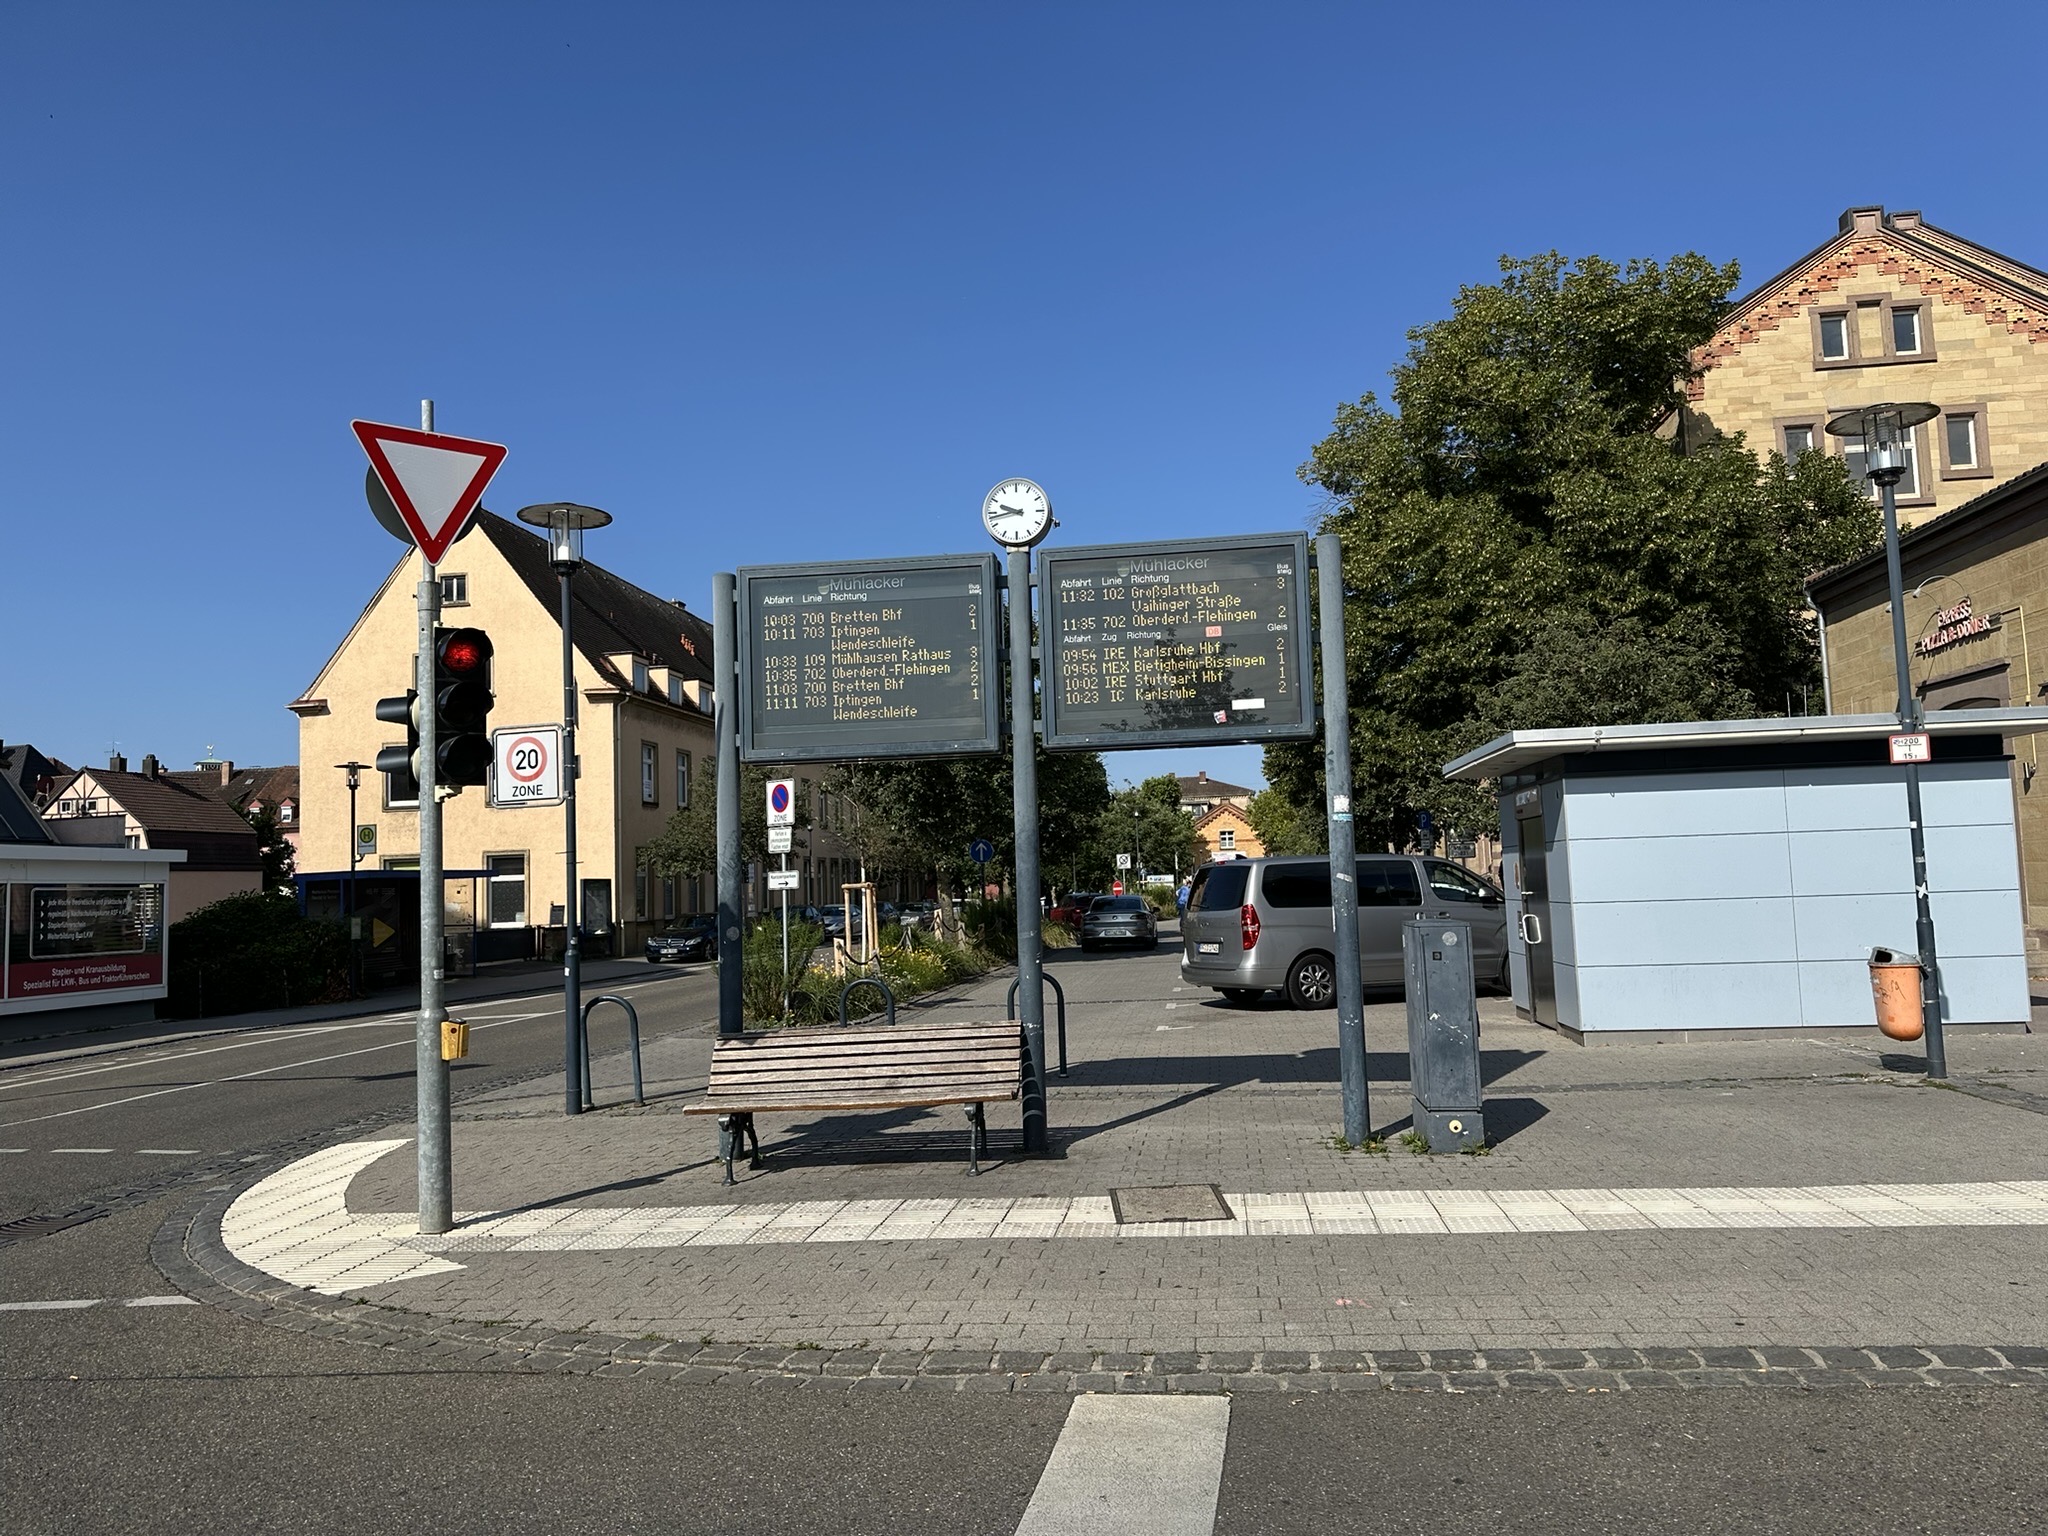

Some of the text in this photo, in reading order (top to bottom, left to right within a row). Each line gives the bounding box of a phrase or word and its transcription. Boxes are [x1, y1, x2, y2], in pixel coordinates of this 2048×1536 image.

[1130, 557, 1209, 573] Mühlacker
[830, 577, 905, 591] Mühlacker
[1061, 574, 1169, 588] Abfahrt Linie Richtung
[1062, 590, 1095, 603] 11:32
[1102, 589, 1125, 600] 102
[1277, 577, 1285, 589] 3
[763, 592, 867, 605] Abfahrt Linie Richtung
[1196, 596, 1241, 609] Straße
[802, 613, 825, 625] 700
[830, 611, 878, 623] Bretten
[882, 609, 903, 621] Bhf
[968, 605, 976, 615] 2
[1063, 618, 1096, 631] 11:35
[1103, 617, 1126, 628] 702
[1278, 606, 1286, 618] 2
[764, 620, 976, 641] 10:11 703 Iptingen 1
[1064, 623, 1288, 643] Abfahrt Zug Richtung DB Gleis
[832, 637, 916, 651] Wendeschleife
[1063, 638, 1284, 662] 09:54 IRE Karlsruhe Hbf 2
[765, 647, 978, 668] 10:33 109 Mühlhausen Rathaus 3
[1063, 653, 1285, 676] 09:56 MEX Bietigheim-Bissingen 1
[765, 670, 797, 682] 10:35
[804, 668, 826, 680] 702
[970, 661, 978, 672] 2
[1065, 668, 1286, 690] 10:02 IRE Stuttgart Hbf 1
[766, 675, 978, 696] 11:03 700 Bretten Bhf 2
[1066, 681, 1286, 704] 10:23 IC Karlsruhe 2
[766, 689, 979, 710] 11:11 703 Iptingen 1
[833, 707, 918, 721] Wendeschleife
[516, 749, 538, 770] 20
[512, 784, 543, 797] ZONE
[774, 814, 787, 822] ZONE
[52, 967, 73, 977] Stapler-
[86, 964, 126, 974] Kranausbildung
[23, 980, 51, 990] Spezialist
[52, 978, 60, 987] für
[79, 977, 89, 985] Bus
[90, 975, 101, 983] und
[102, 973, 150, 983] Traktorführerschein
